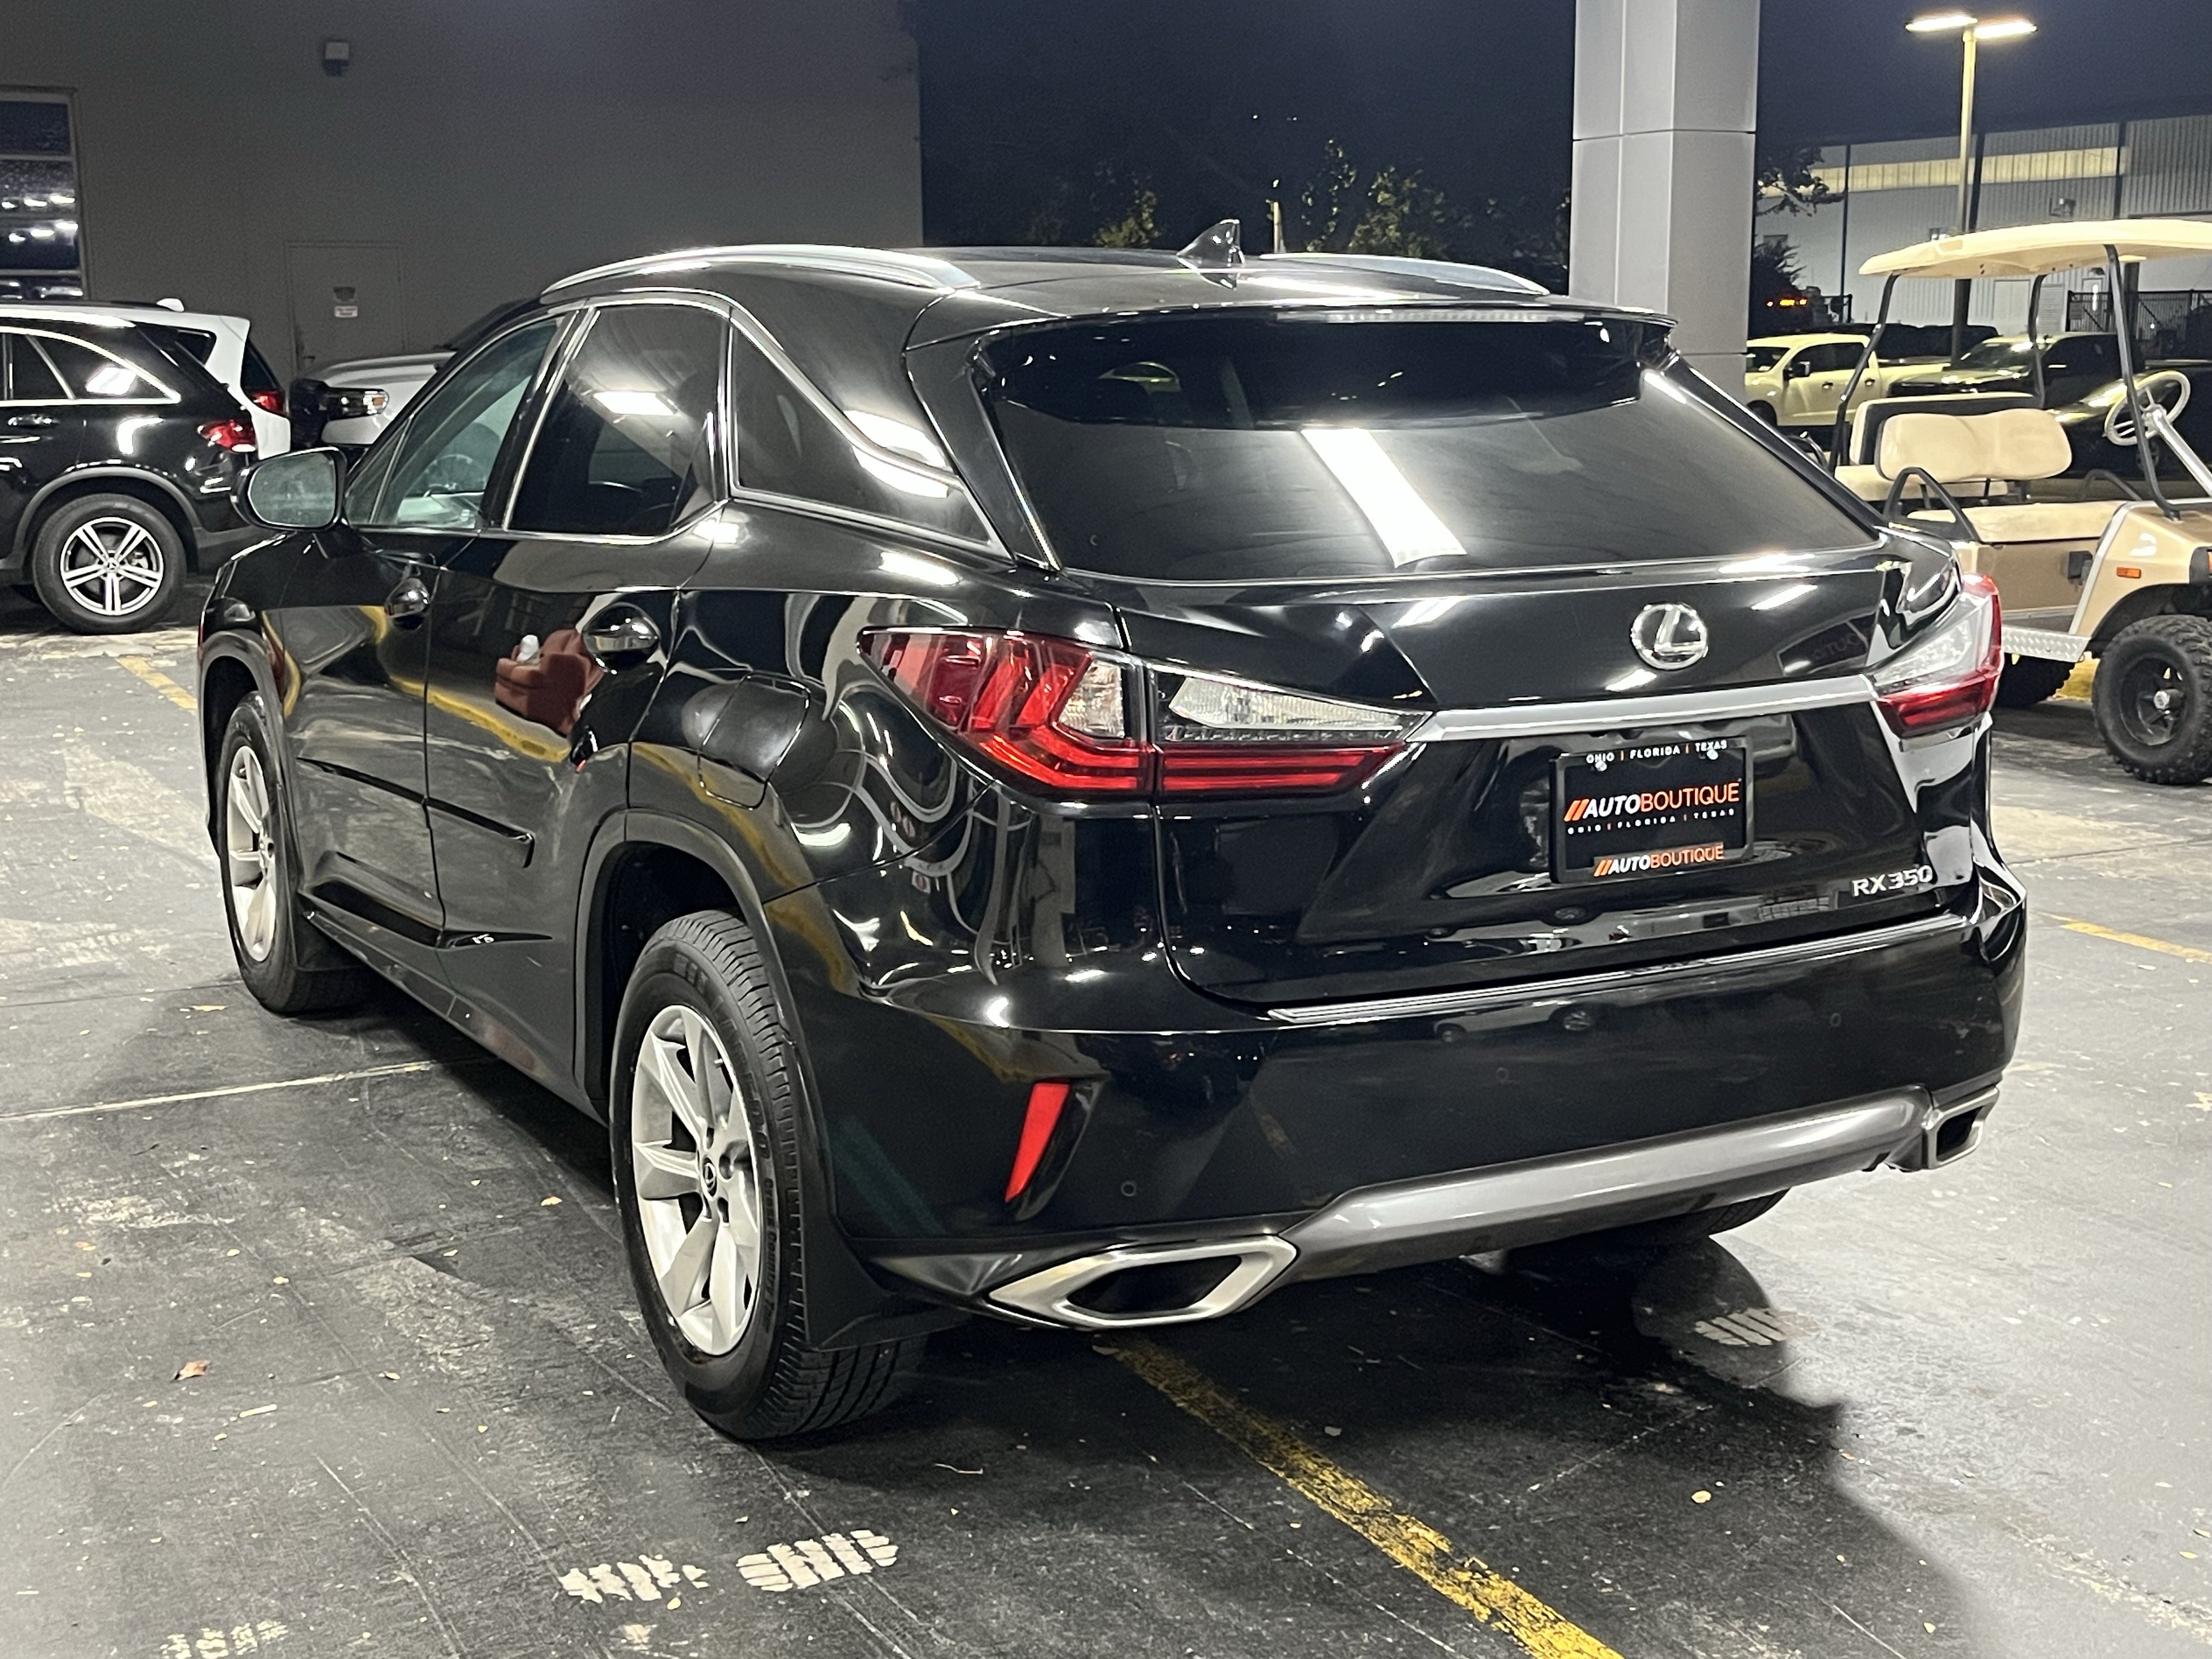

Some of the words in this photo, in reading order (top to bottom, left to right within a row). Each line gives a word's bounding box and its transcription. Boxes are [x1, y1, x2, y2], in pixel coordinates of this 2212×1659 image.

[1586, 752, 1615, 764] OHIO
[1629, 745, 1680, 759] FLORIDA
[1695, 740, 1727, 752] TEXAS
[1582, 782, 1740, 819] AUTOBOUTIQUE
[1607, 845, 1724, 875] AUTOBOUTIQUE
[1852, 874, 1886, 897] RX
[1888, 865, 1933, 890] 350
